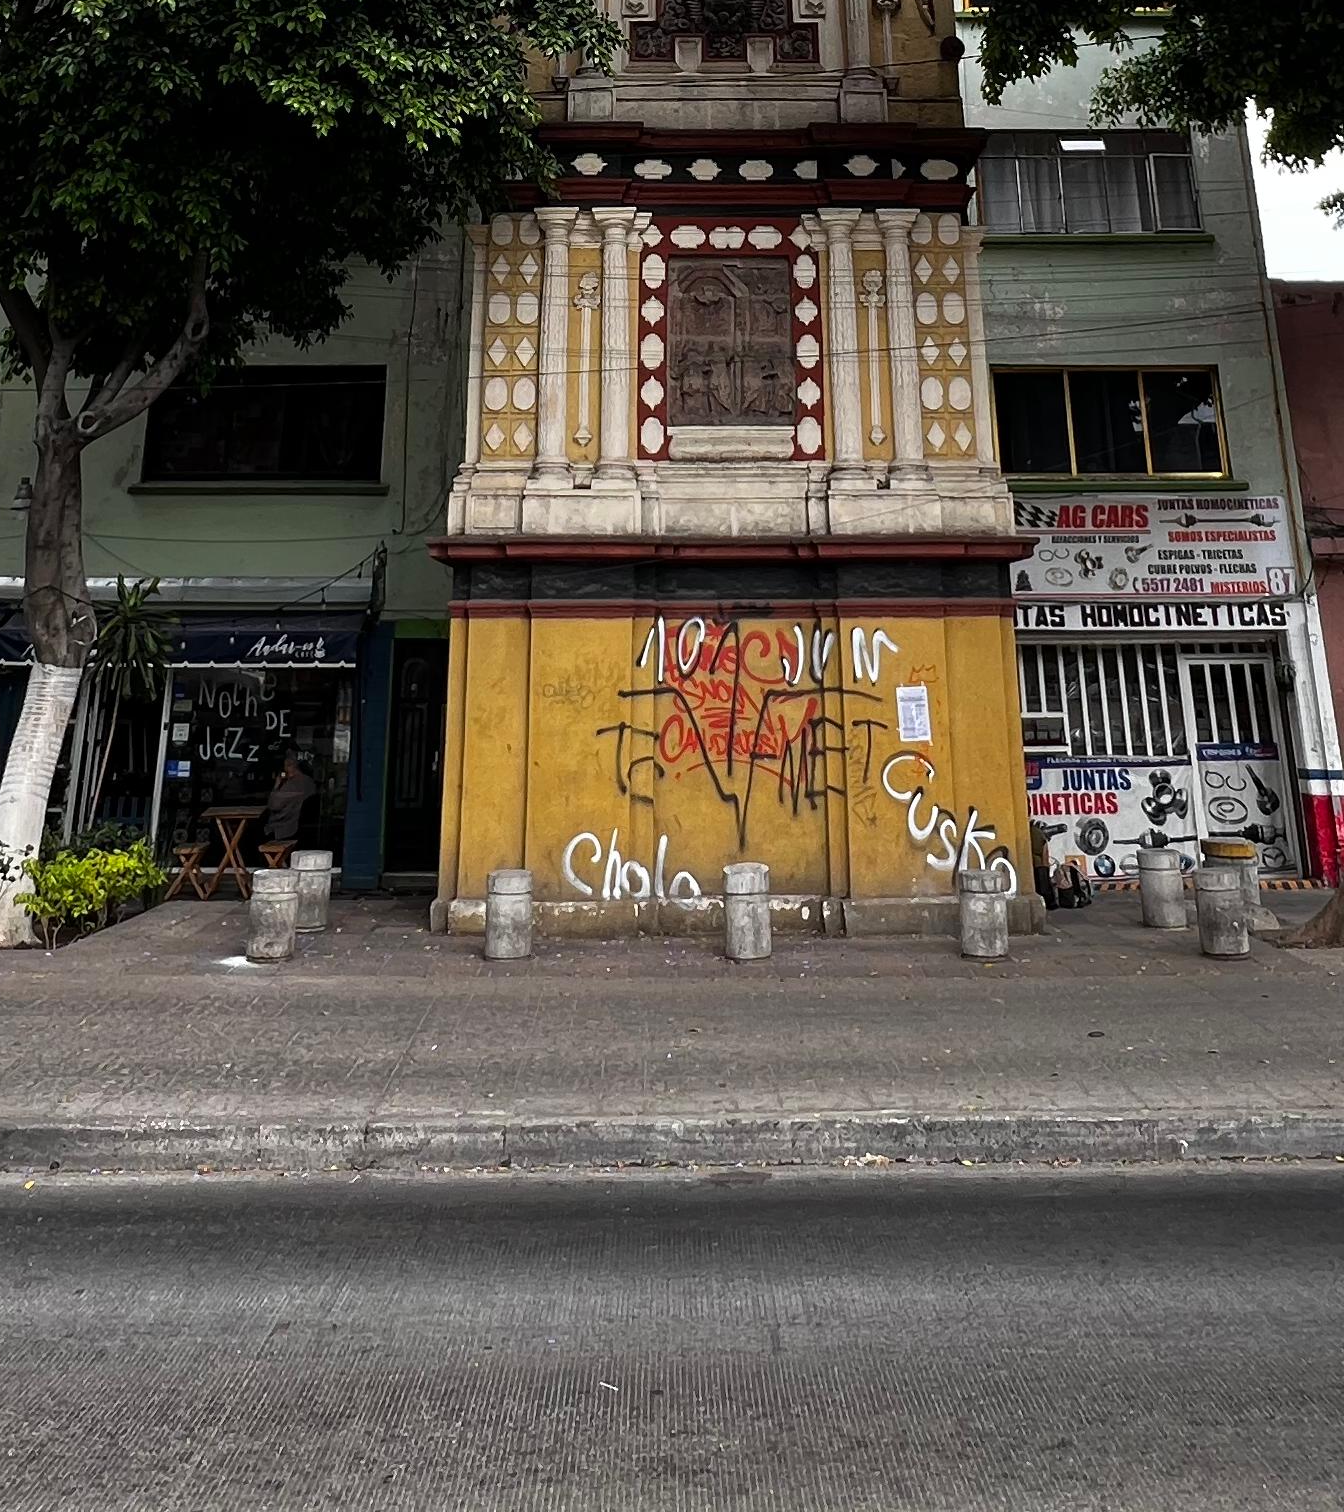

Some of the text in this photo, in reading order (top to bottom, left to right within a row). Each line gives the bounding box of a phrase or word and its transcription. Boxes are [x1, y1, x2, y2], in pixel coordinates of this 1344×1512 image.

[1157, 497, 1279, 510] JUNTAS HOMOCINETICAS
[1057, 504, 1149, 528] AG CARS
[1051, 535, 1140, 544] REFACCIONES Y SERVICIOS
[1168, 530, 1276, 543] SOMOS ESPECIALISTAS
[1158, 549, 1243, 560] ESPIGAS TRICETAS
[1147, 563, 1256, 575] CUBRE POLVOS FLECHAS
[1141, 568, 1296, 595] 5517 2481 MISTERIOS 87
[1013, 605, 1065, 627] TAS
[265, 709, 292, 738] DE
[1062, 768, 1132, 791] JUNTAS
